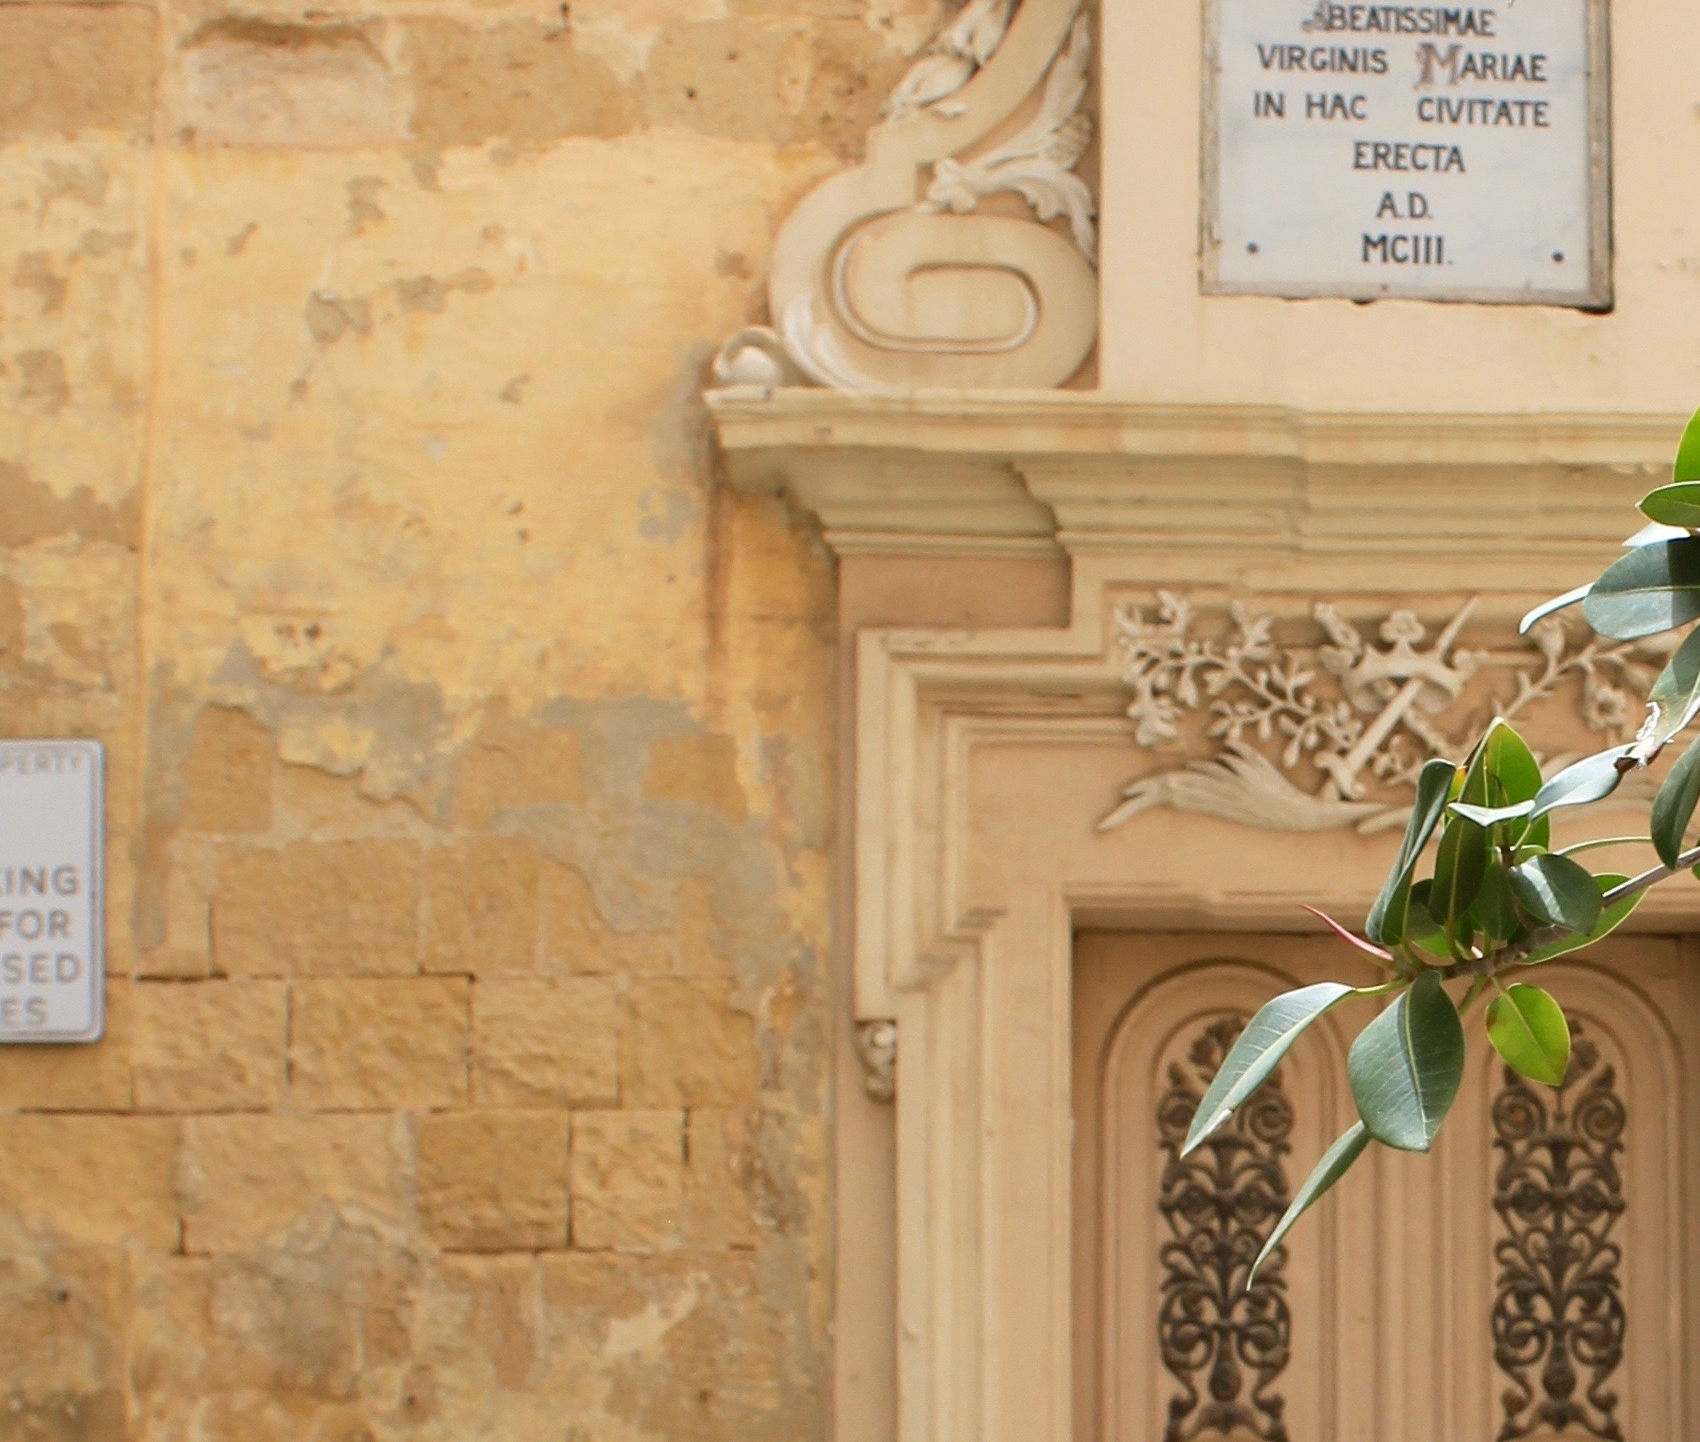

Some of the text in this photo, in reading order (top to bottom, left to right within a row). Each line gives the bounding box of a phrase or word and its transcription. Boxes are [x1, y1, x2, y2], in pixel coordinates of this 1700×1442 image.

[1256, 42, 1548, 90] VIRGINIS MARIAE
[1254, 92, 1550, 127] IN HAC CIVITATE
[1352, 141, 1466, 173] ERECTA
[0, 865, 79, 896] ING
